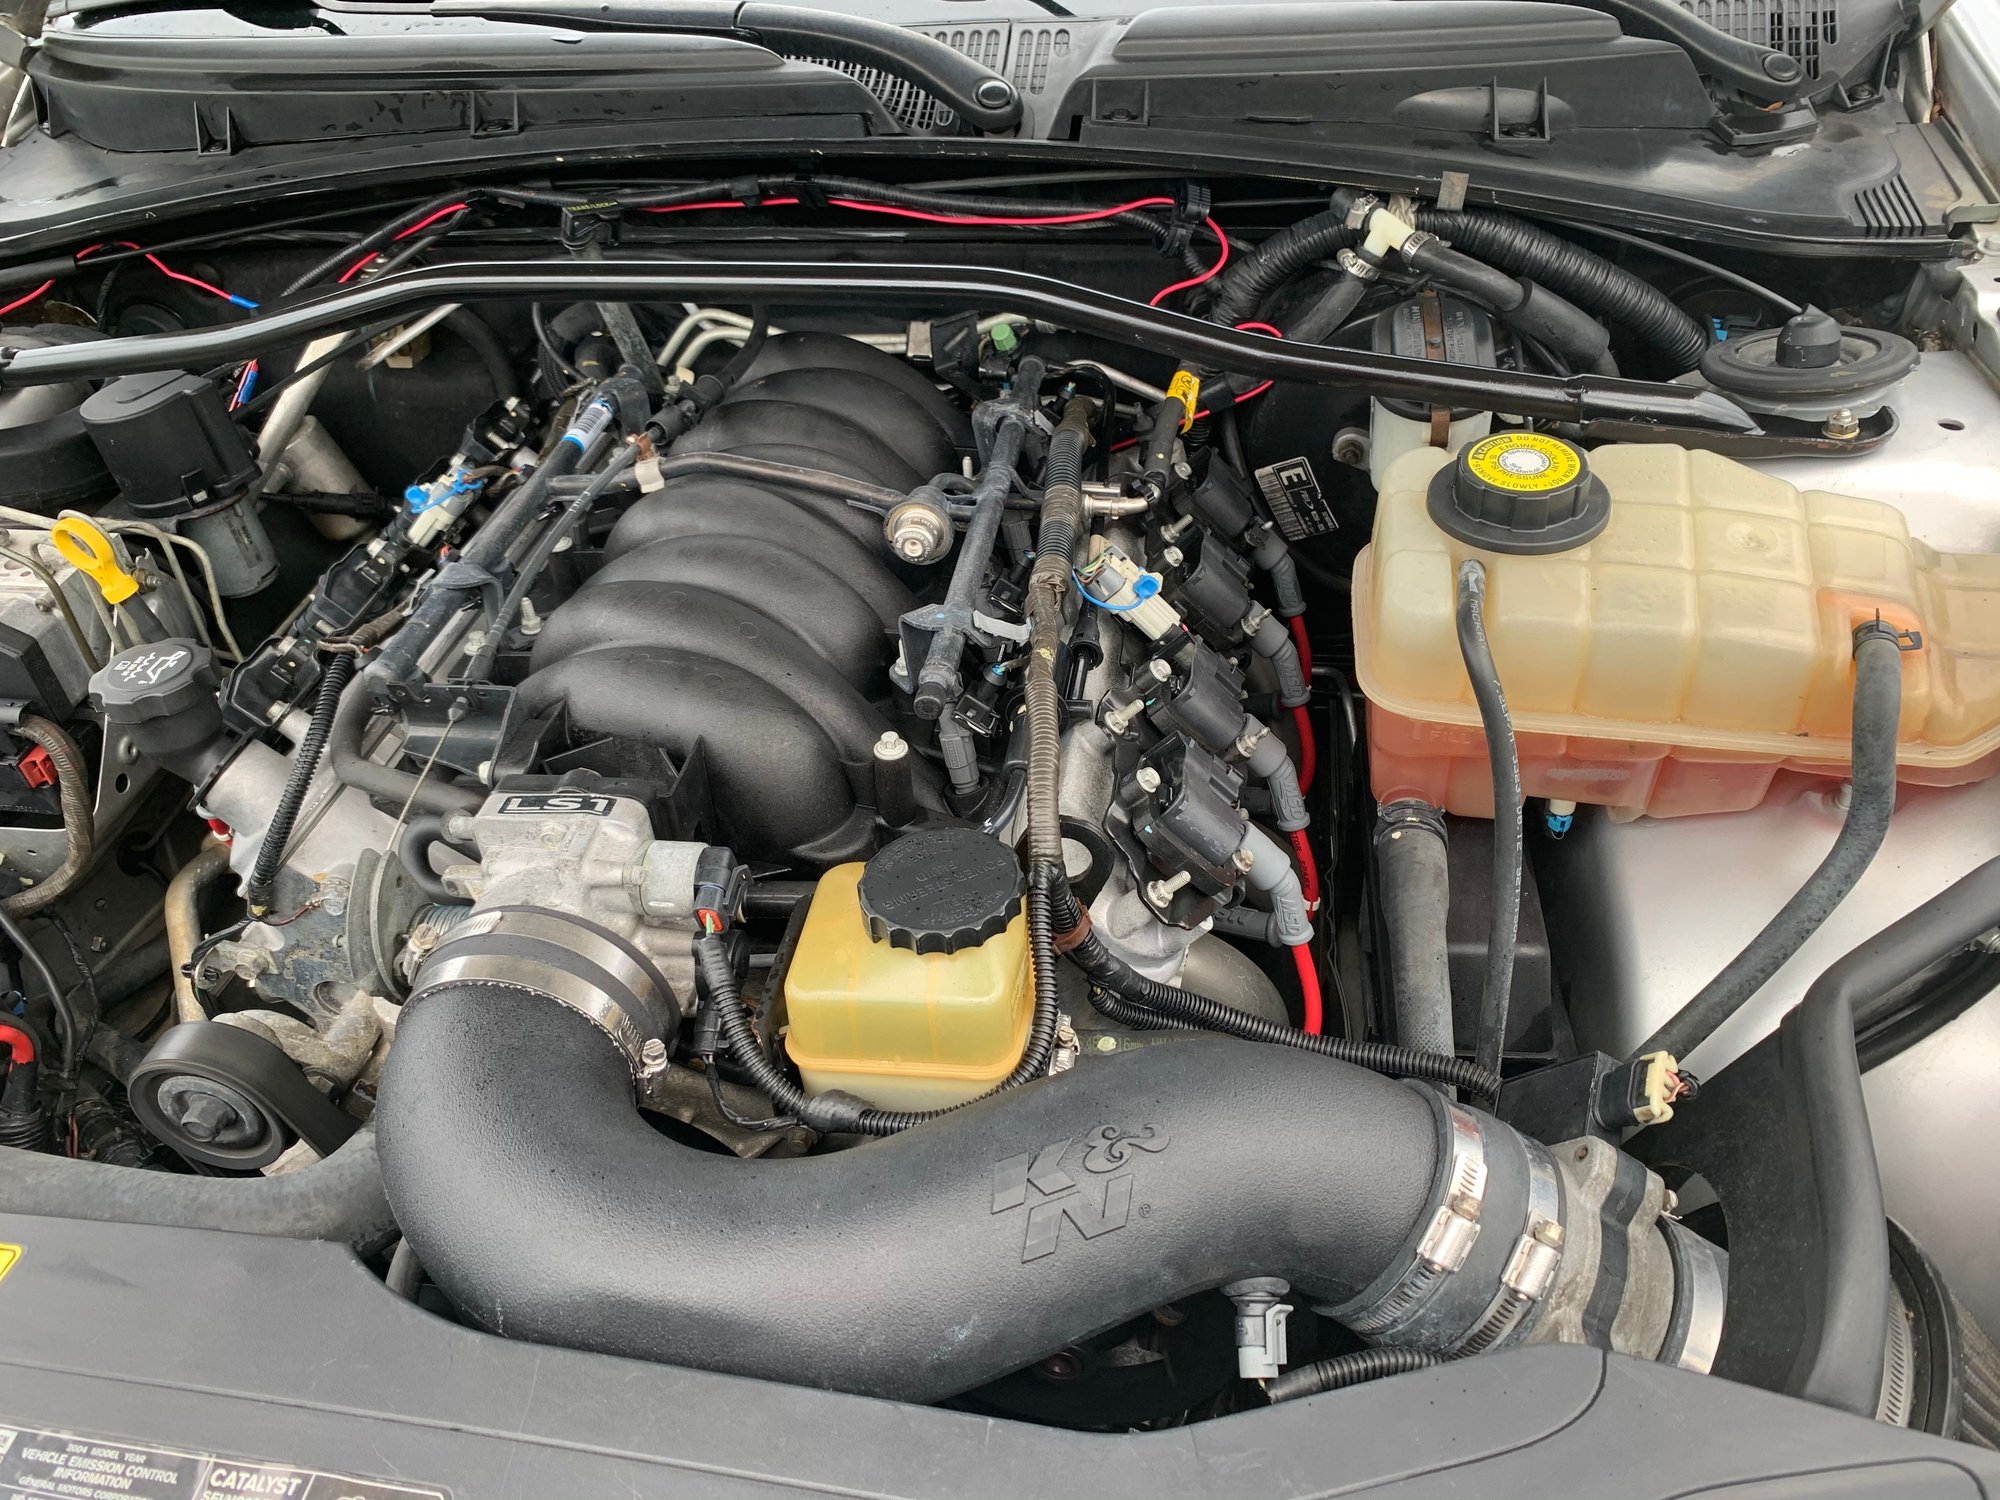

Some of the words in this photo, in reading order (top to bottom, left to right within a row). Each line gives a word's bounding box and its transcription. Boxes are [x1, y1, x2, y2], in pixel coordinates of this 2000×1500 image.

[1481, 436, 1512, 455] CAUTION
[1533, 436, 1550, 445] NOT
[1498, 443, 1537, 452] ENGINE
[1539, 447, 1560, 473] COOLANT
[1552, 442, 1576, 463] REMOVE
[1473, 463, 1498, 482] REMOVE
[1500, 480, 1539, 490] SLOWLY
[1497, 469, 1549, 481] PRESSURE
[1548, 477, 1565, 487] HOT
[1563, 463, 1577, 479] WHEN
[506, 796, 609, 813] LS1
[953, 856, 1007, 882] POWER
[1300, 858, 1311, 890] SPARK
[882, 878, 953, 911] STEERING
[1280, 898, 1302, 936] MSD
[66, 1443, 88, 1454] 2004
[90, 1447, 120, 1460] MODEL
[124, 1452, 147, 1464] YEAR
[22, 1447, 68, 1466] VEHICLE
[68, 1455, 126, 1475] EMISSION
[125, 1465, 178, 1485] CONTROL
[18, 1476, 56, 1491] GENERAL
[57, 1483, 93, 1497] MOTORS
[53, 1466, 133, 1490] INFORMATION
[210, 1468, 302, 1496] CATALYST
